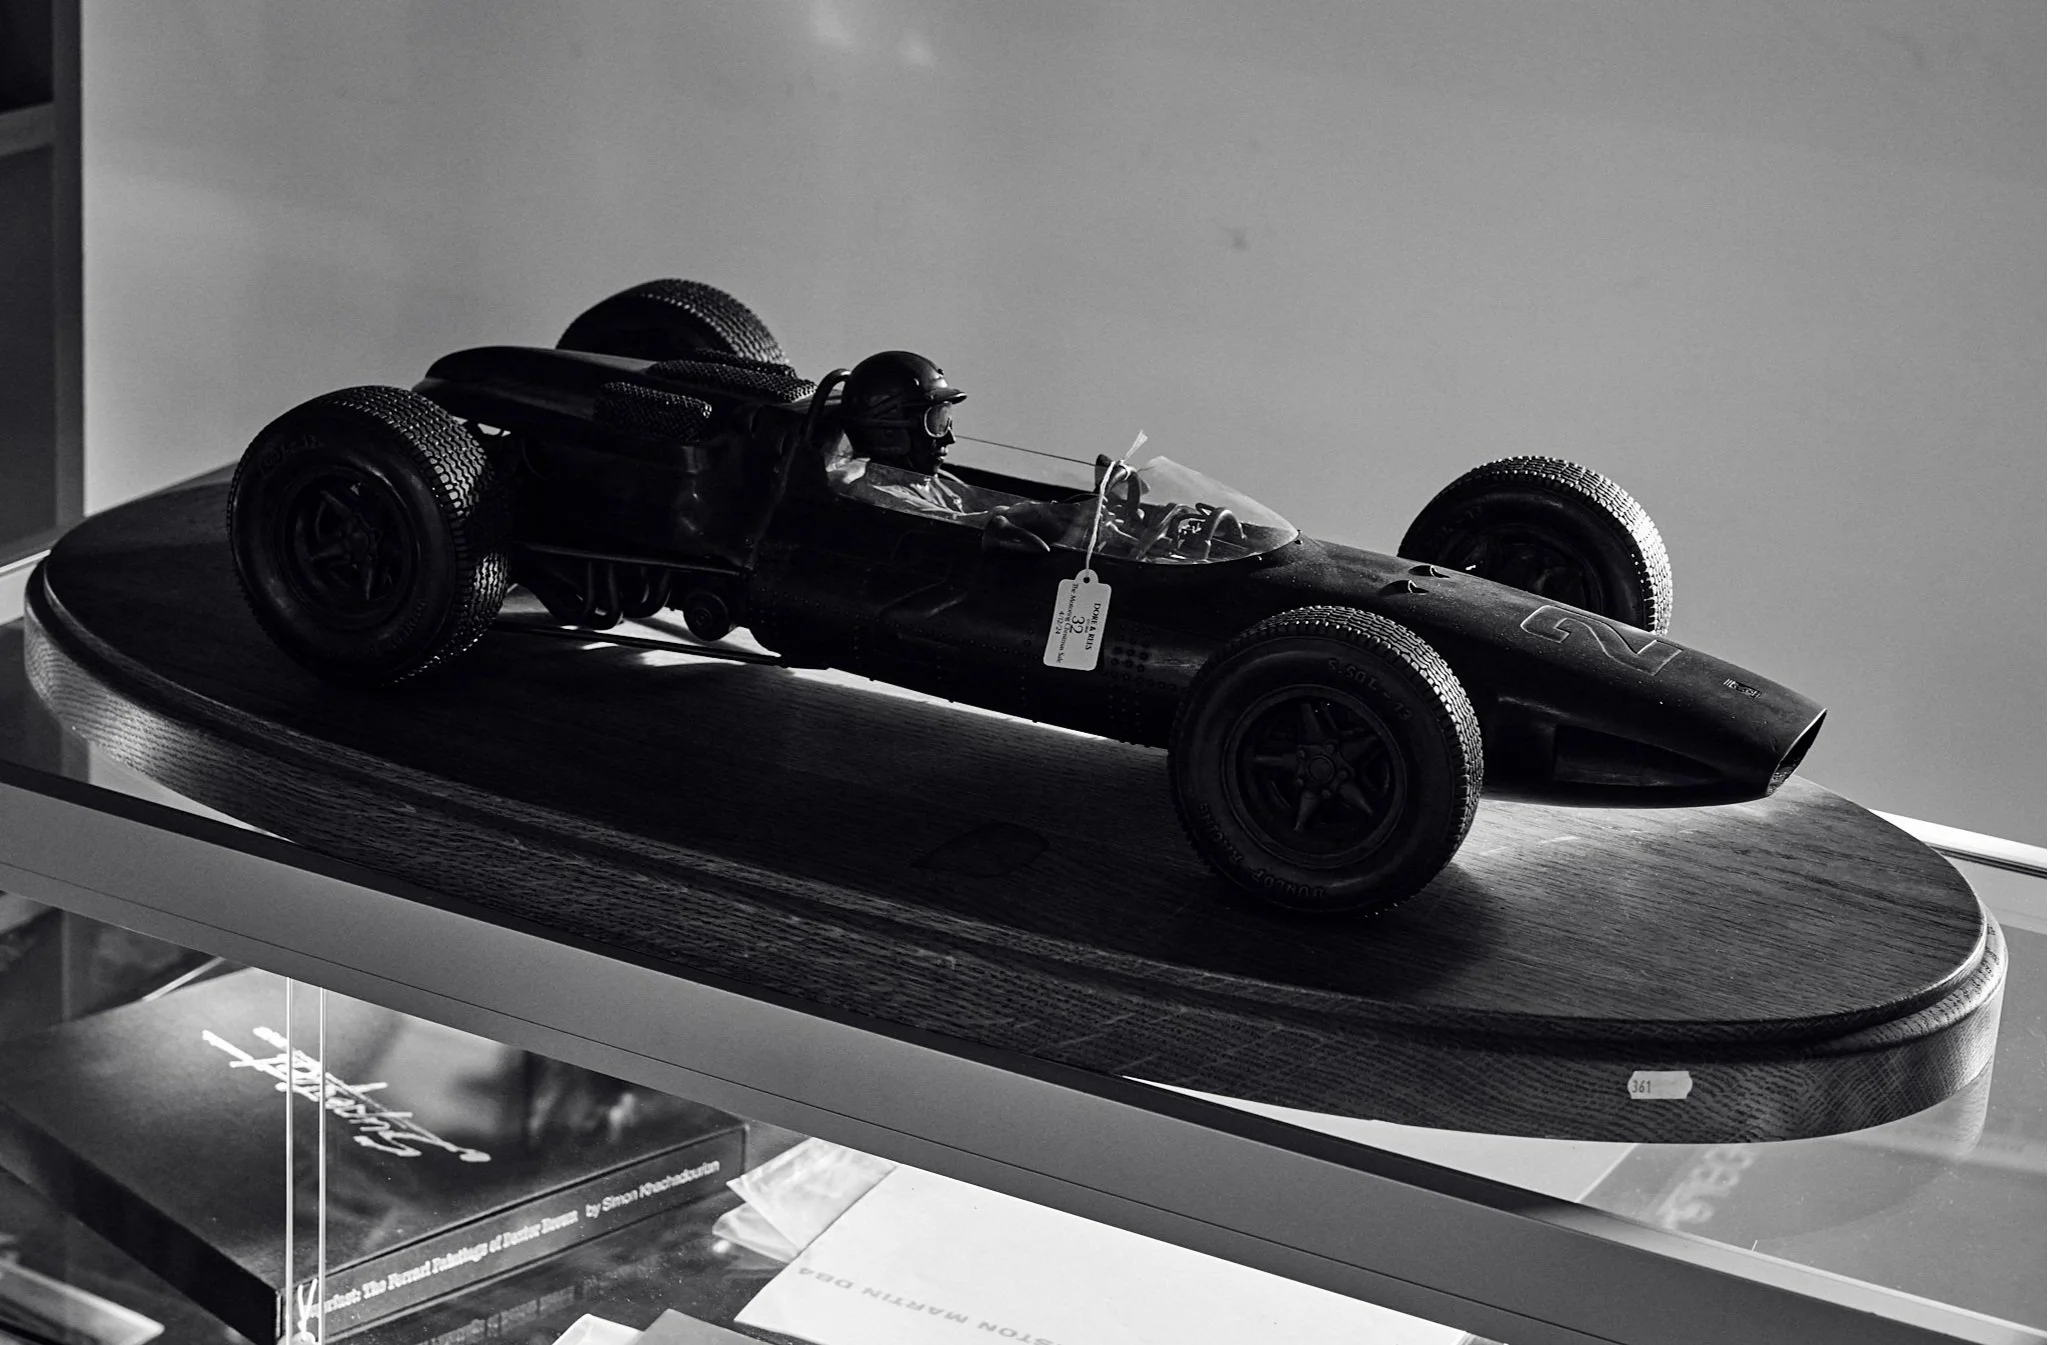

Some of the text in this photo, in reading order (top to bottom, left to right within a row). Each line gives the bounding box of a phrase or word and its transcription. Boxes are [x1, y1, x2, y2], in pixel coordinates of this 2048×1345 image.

[1065, 595, 1076, 622] Motoring
[1092, 603, 1101, 623] DORE
[1055, 611, 1064, 634] 4/12/24
[1069, 616, 1085, 633] 32
[1059, 622, 1071, 651] Christmas
[1086, 633, 1095, 650] REES
[1519, 604, 1683, 677] 2
[1248, 866, 1325, 898] DUNLOP
[1630, 1078, 1652, 1094] 361
[362, 1280, 387, 1299] The
[388, 1260, 431, 1290] Ferrari
[432, 1242, 488, 1274] Paintings
[489, 1234, 502, 1253] of
[585, 1203, 601, 1218] by
[602, 1190, 638, 1212] Simon
[639, 1160, 720, 1198] Khachadourian
[797, 1267, 1061, 1345] STON MARTIN DB4
